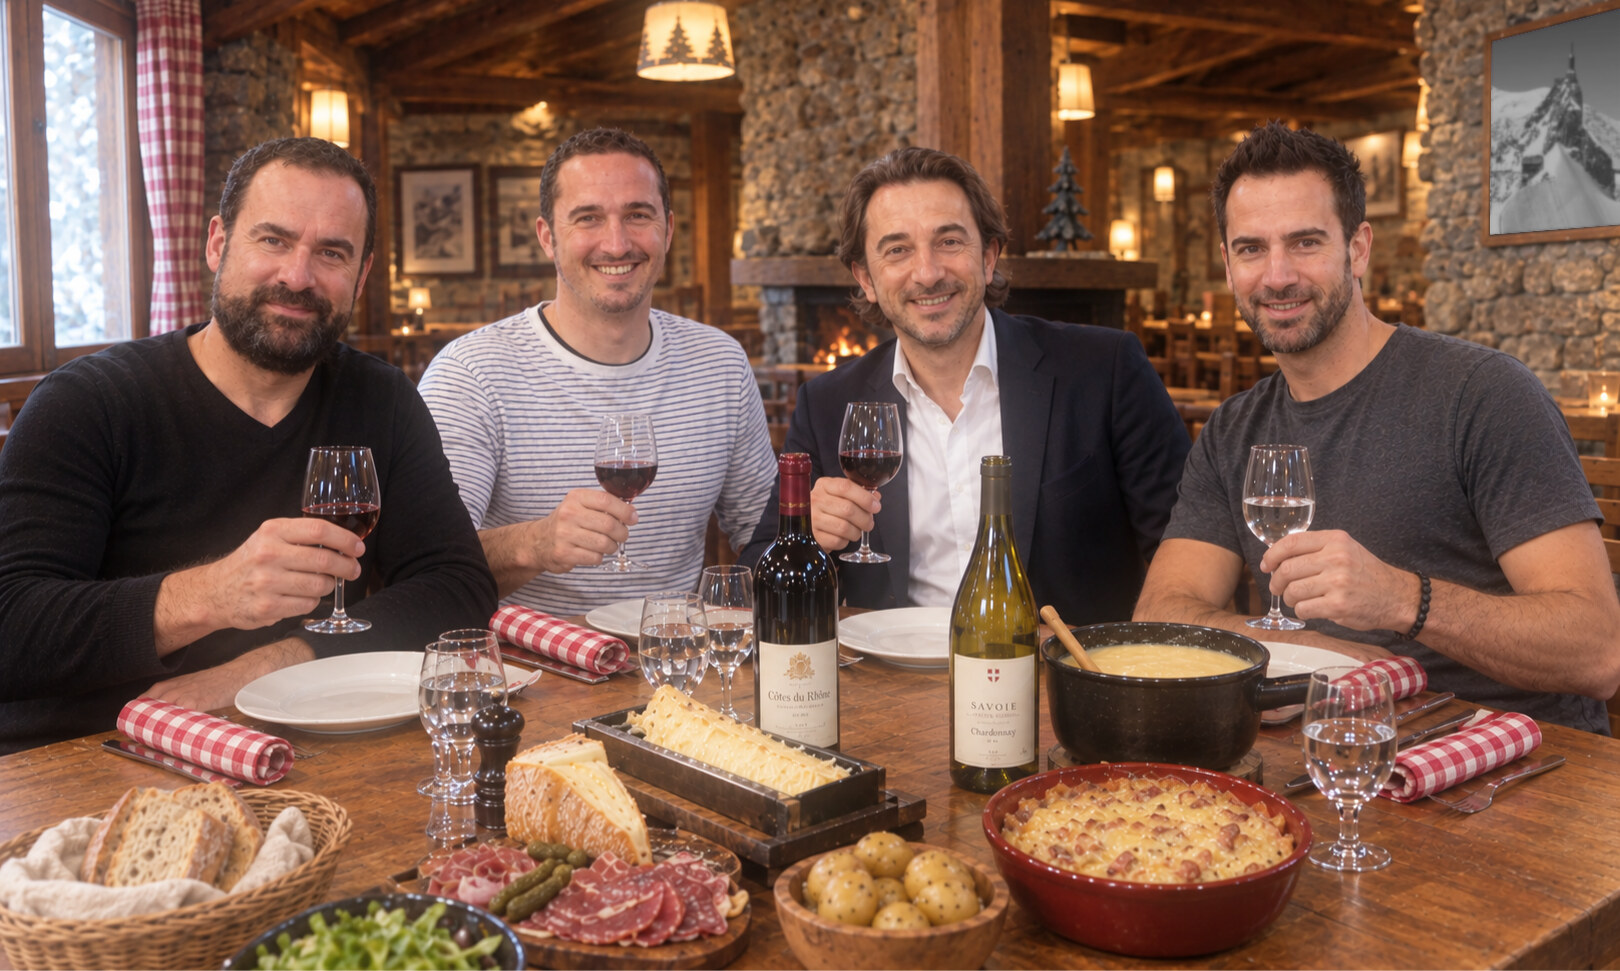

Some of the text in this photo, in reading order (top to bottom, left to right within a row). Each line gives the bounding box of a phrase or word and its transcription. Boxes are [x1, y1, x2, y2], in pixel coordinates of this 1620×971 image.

[768, 690, 831, 702] Côtes du Rhône
[970, 701, 1017, 711] SAVOIE
[970, 727, 1017, 738] Chardonnay
